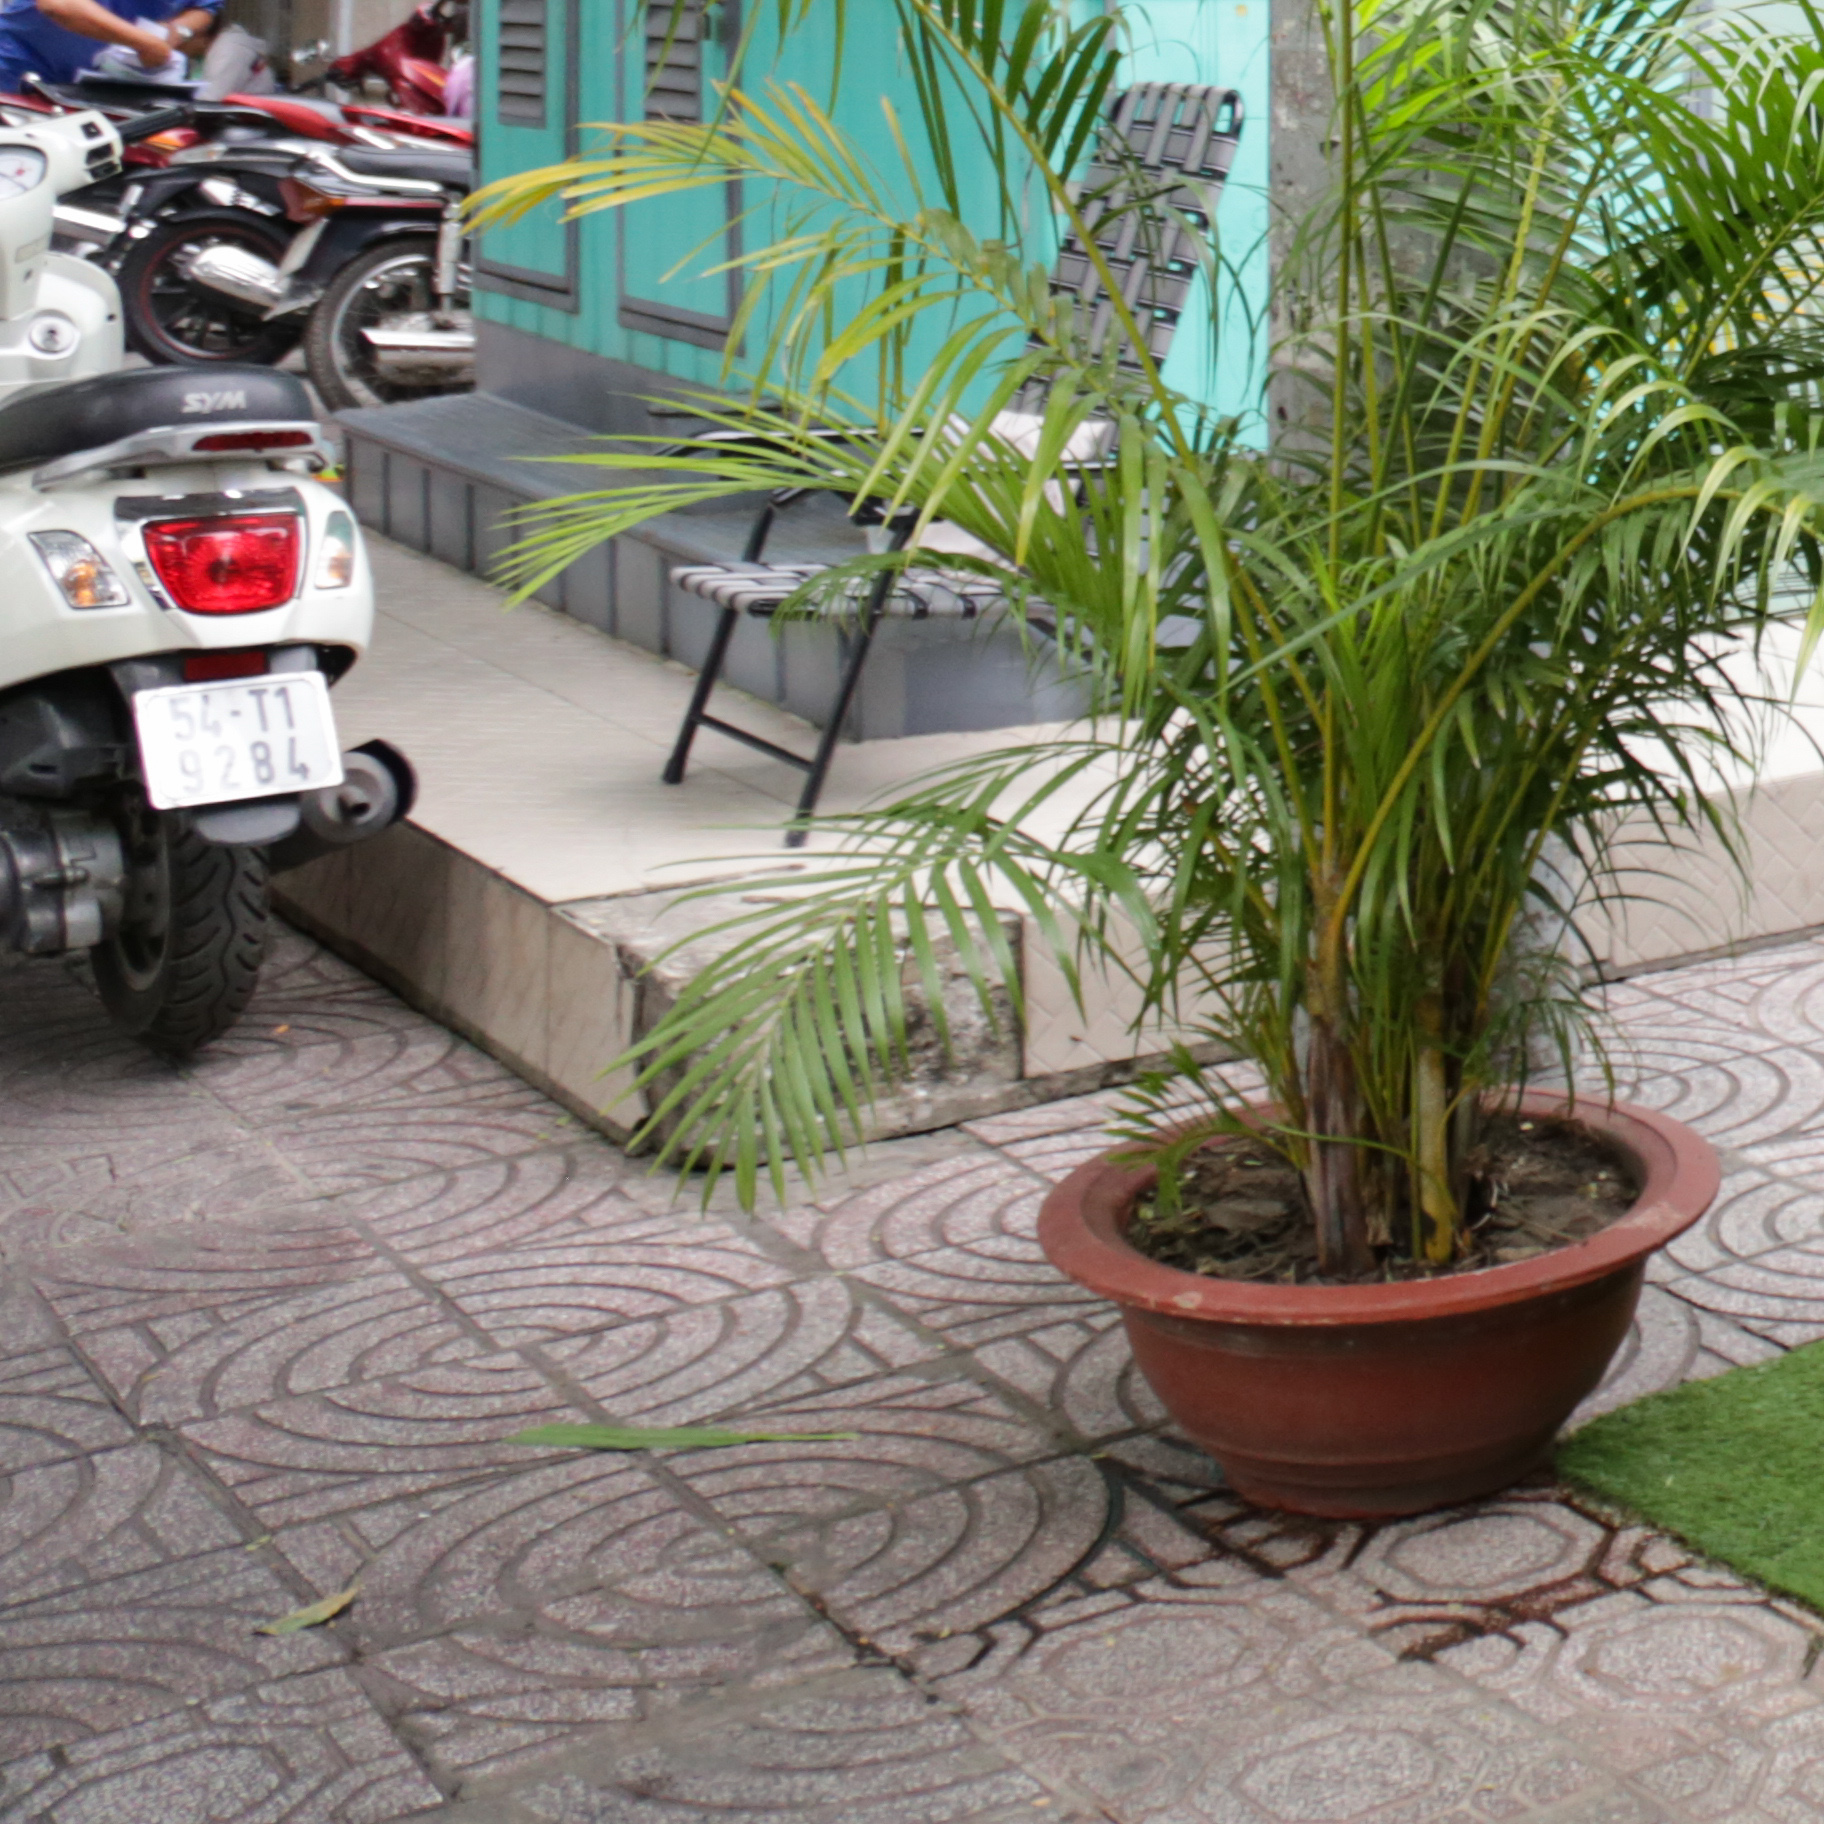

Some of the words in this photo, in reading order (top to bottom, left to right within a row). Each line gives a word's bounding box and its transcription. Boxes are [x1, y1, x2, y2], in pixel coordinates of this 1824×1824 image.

[180, 389, 247, 415] SYM
[169, 686, 296, 741] 54-T1
[178, 737, 311, 793] 9284
